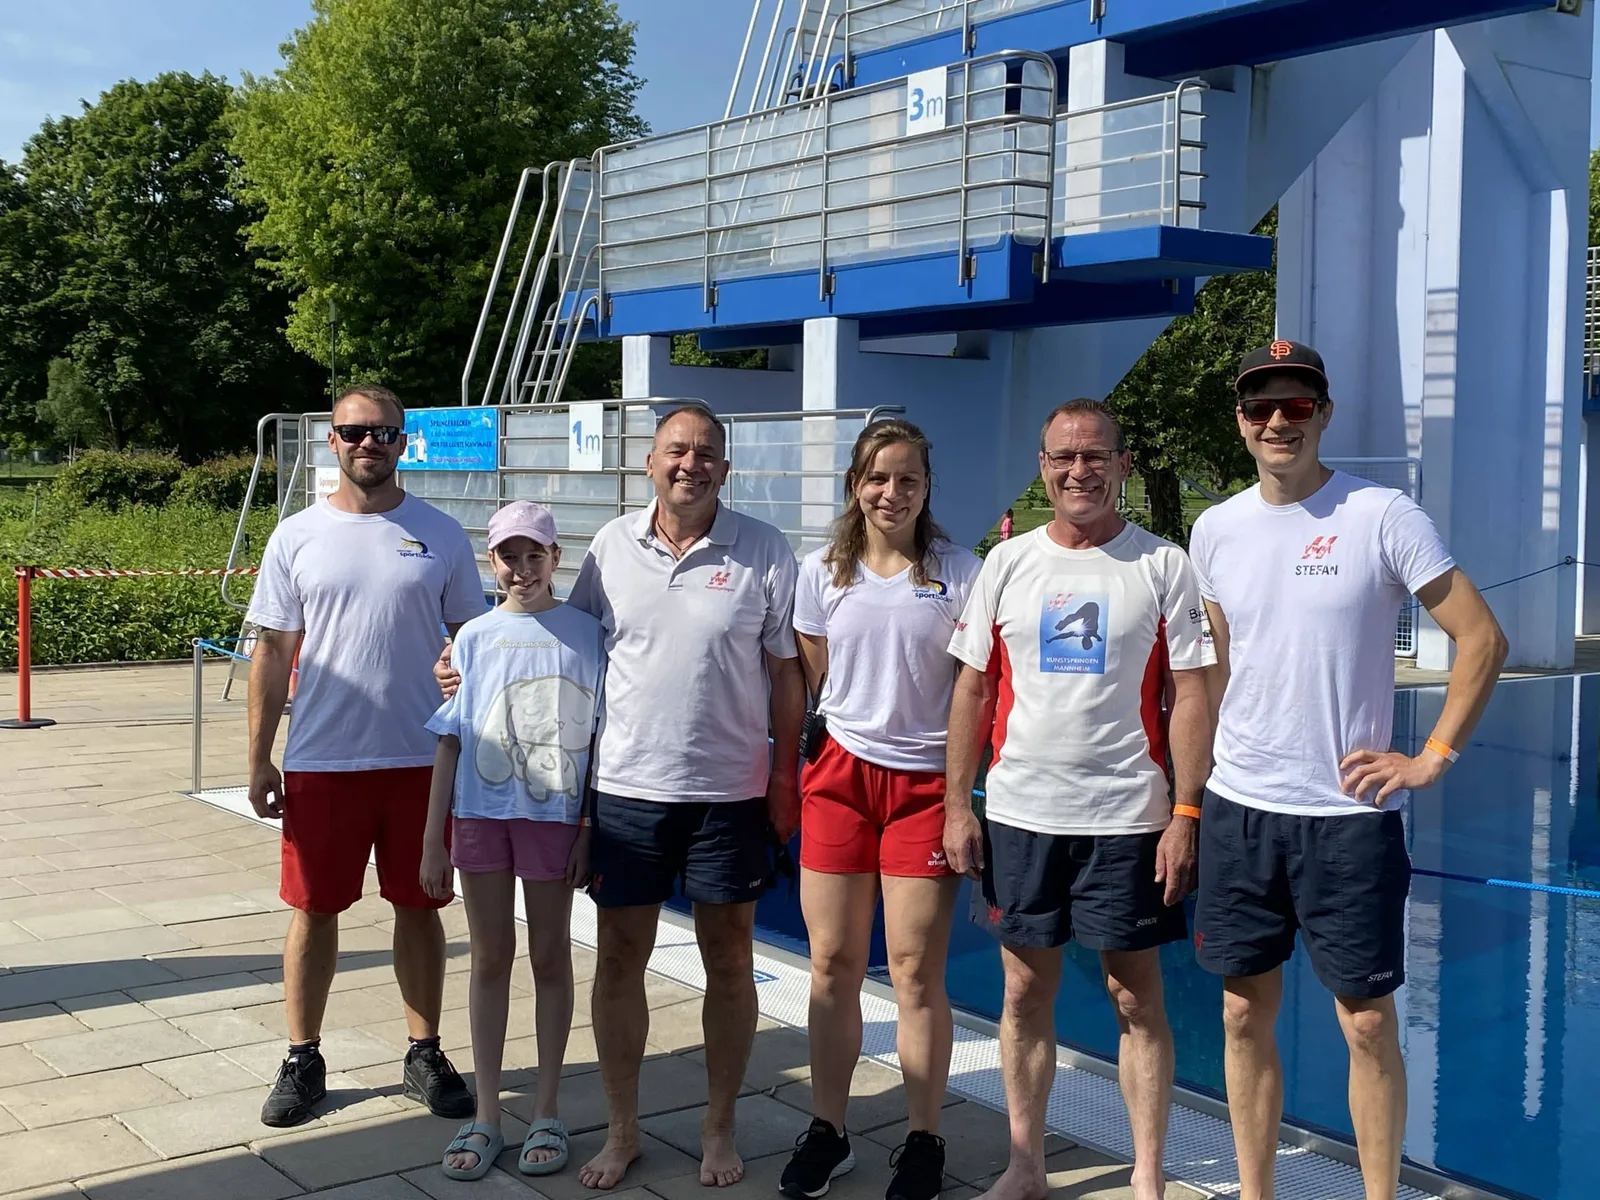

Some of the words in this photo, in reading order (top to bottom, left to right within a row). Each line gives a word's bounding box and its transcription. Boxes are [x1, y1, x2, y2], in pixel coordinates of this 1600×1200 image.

[909, 87, 943, 122] 3m
[572, 420, 600, 455] 1m
[1295, 564, 1339, 576] STEFAN
[1366, 970, 1394, 982] STEFAN
